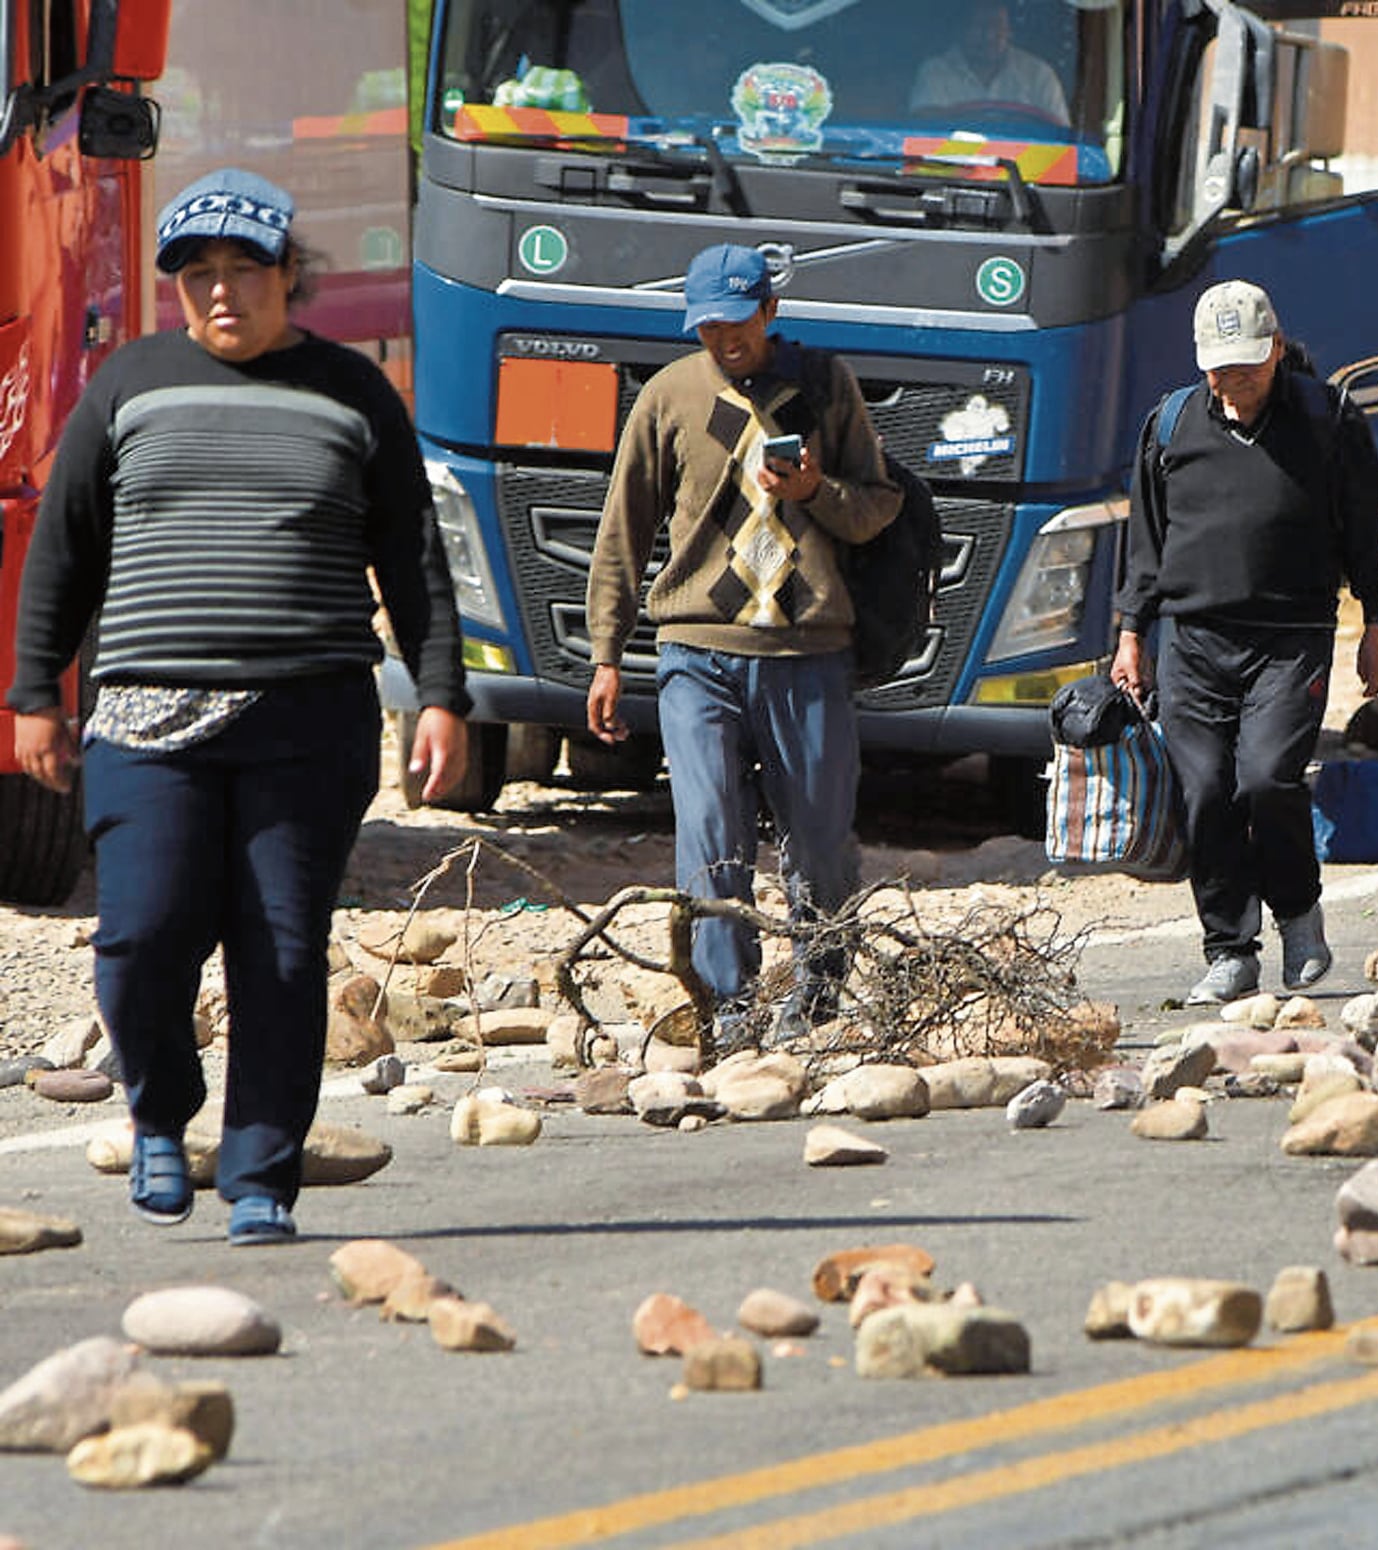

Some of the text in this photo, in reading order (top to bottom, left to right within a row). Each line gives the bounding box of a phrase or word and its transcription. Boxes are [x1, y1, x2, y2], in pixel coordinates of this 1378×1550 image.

[533, 234, 553, 266] L
[989, 266, 1013, 298] S
[512, 338, 600, 357] VOLVO
[984, 368, 1016, 385] FH
